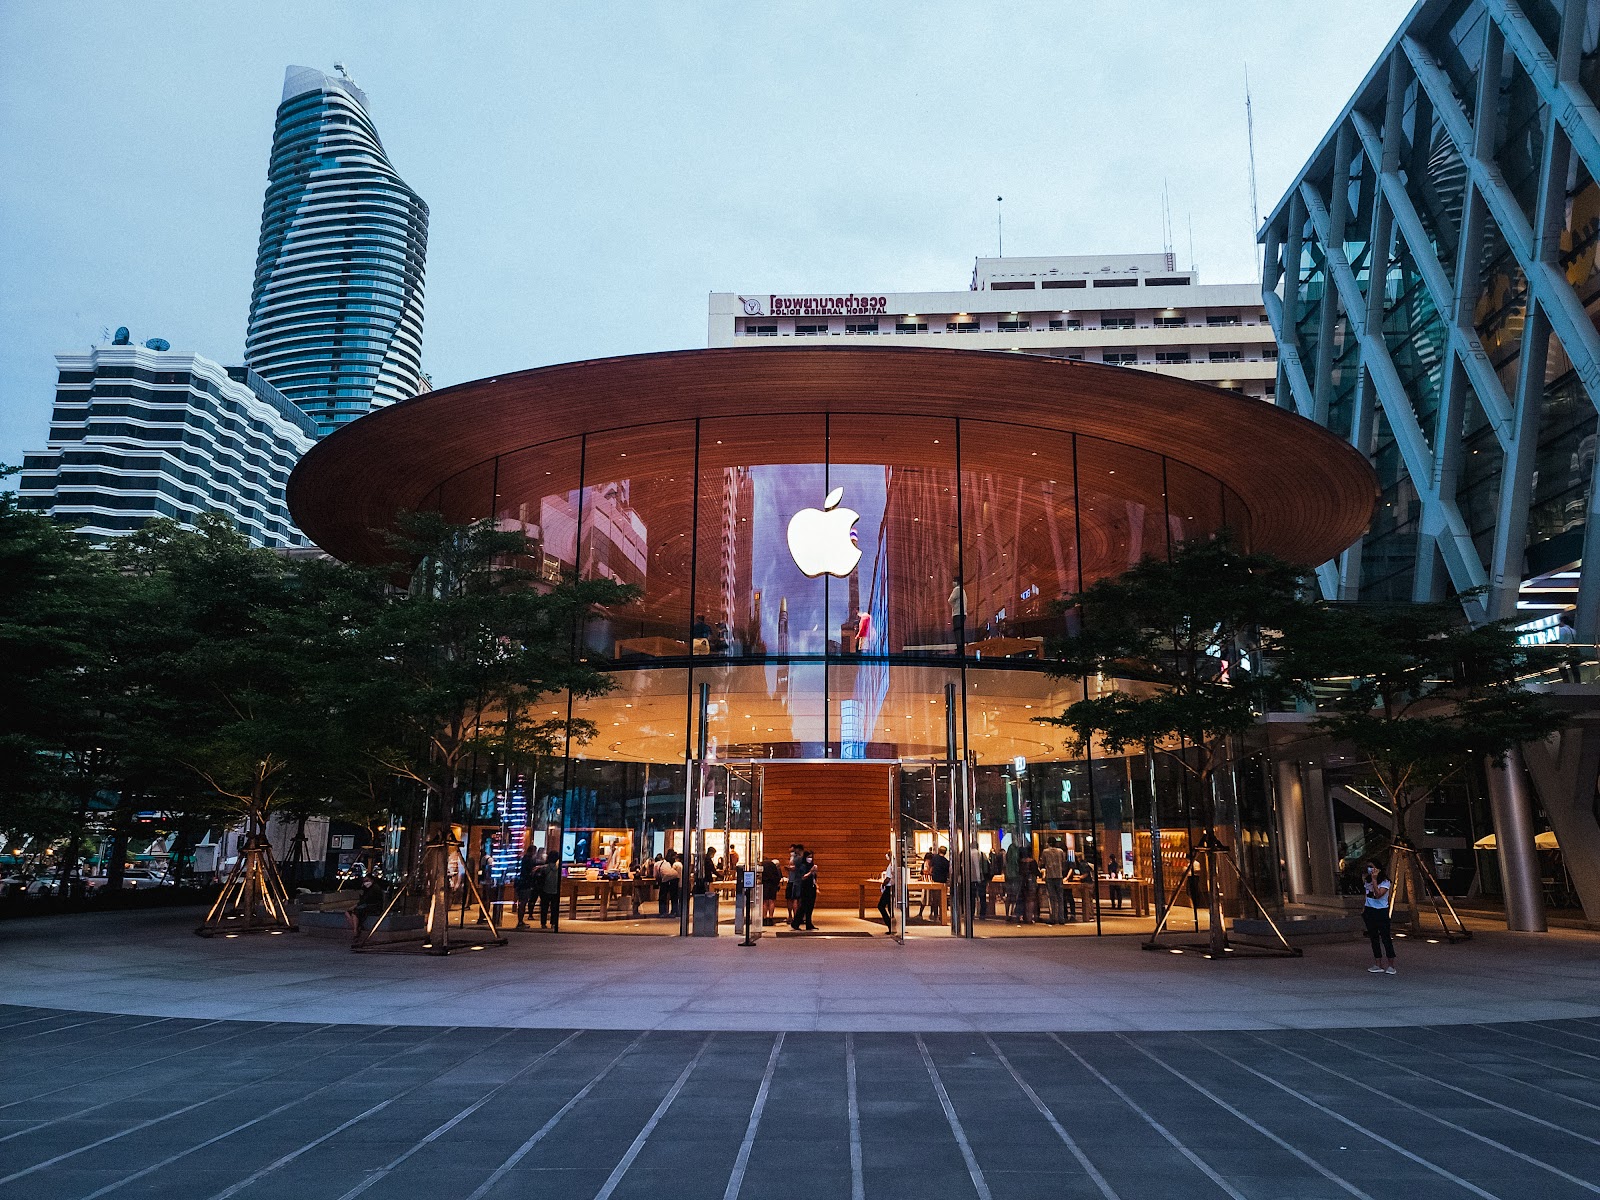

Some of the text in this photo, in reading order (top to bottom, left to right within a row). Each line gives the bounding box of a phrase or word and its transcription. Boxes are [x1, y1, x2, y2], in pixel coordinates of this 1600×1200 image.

[770, 294, 887, 309] โรงพยาบาลตำรวจ
[846, 307, 887, 315] HOSPITAL
